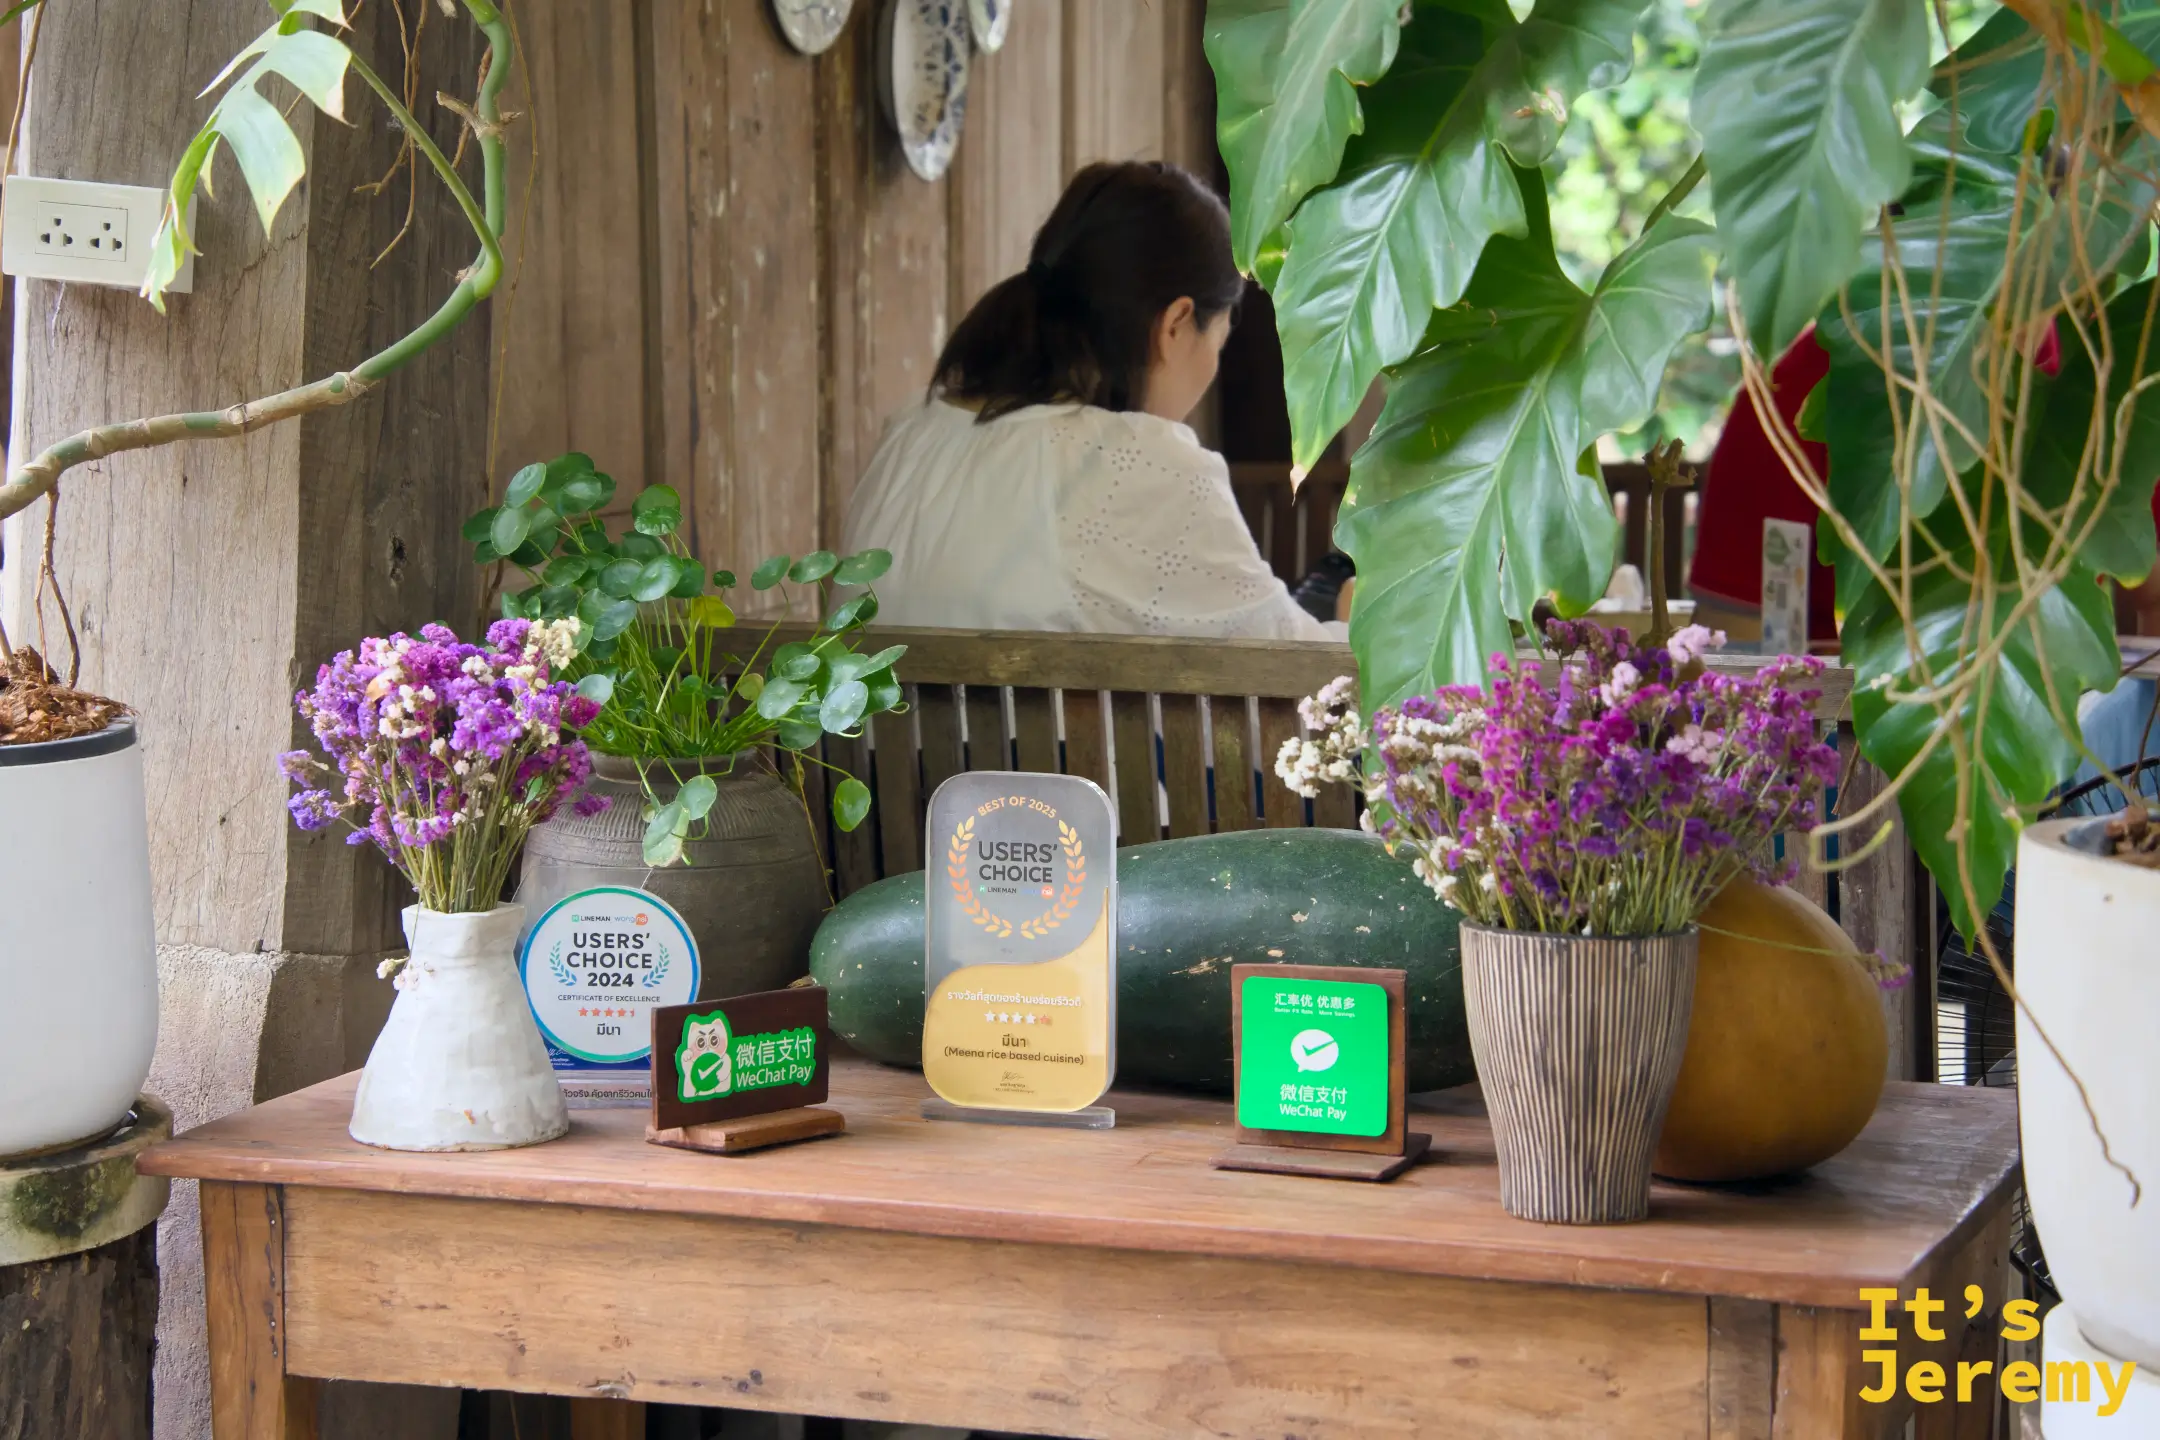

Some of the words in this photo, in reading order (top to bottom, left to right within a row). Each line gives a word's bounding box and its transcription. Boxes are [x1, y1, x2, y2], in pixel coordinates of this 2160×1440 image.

[977, 797, 1005, 817] BEST
[1009, 796, 1026, 807] OF
[1028, 798, 1057, 819] 2025
[978, 841, 1058, 863] USERS'
[978, 864, 1053, 883] CHOICE
[573, 932, 651, 949] USERS'
[566, 952, 653, 969] CHOICE
[587, 972, 634, 987] 2024
[558, 994, 602, 1002] CERTIFICATE
[615, 995, 661, 1003] EXCELLENCE
[1274, 993, 1313, 1008] 汇率优
[1317, 995, 1356, 1010] 优惠多
[596, 1024, 621, 1036] มีนา
[1002, 1034, 1027, 1048] มีนา
[736, 1034, 812, 1069] 微信支付
[944, 1046, 985, 1058] (Meena
[986, 1049, 1006, 1059] rice
[1009, 1050, 1041, 1061] based
[1043, 1052, 1085, 1065] cuisine)
[736, 1068, 786, 1088] WeChat
[789, 1064, 812, 1082] Pay
[1279, 1084, 1347, 1105] 微信支付
[1279, 1104, 1323, 1118] WeChat
[1327, 1105, 1347, 1121] Pay
